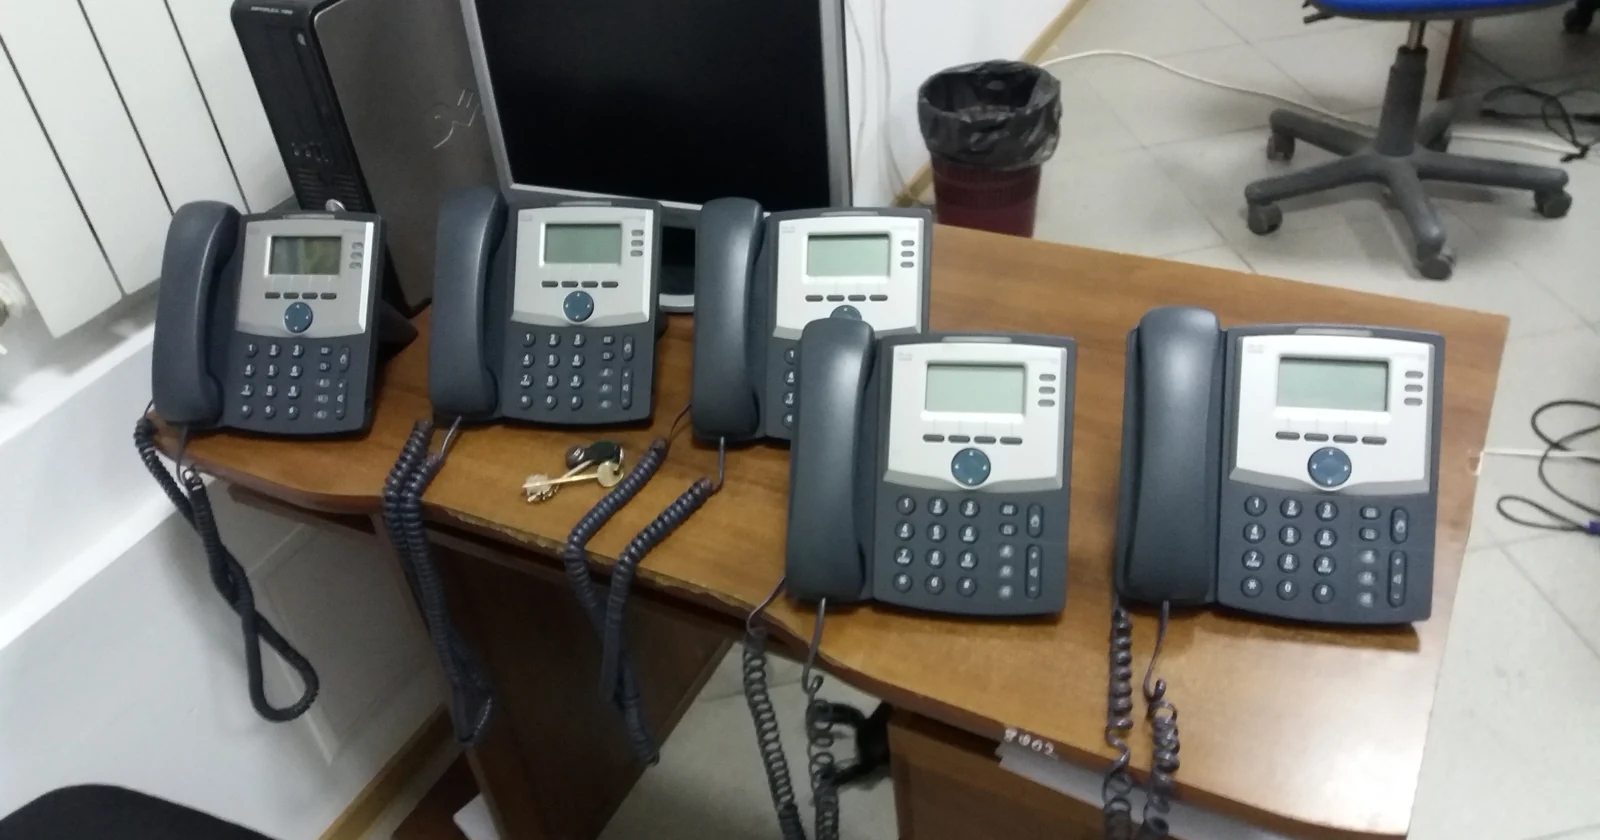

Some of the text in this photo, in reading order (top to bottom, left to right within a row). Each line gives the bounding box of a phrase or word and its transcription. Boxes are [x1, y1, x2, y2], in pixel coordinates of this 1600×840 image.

[904, 498, 909, 508] 1
[1254, 497, 1259, 508] 1
[1289, 500, 1295, 510] 2
[1252, 524, 1258, 534] 4
[1251, 551, 1257, 561] 7
[1285, 581, 1292, 592] 0
